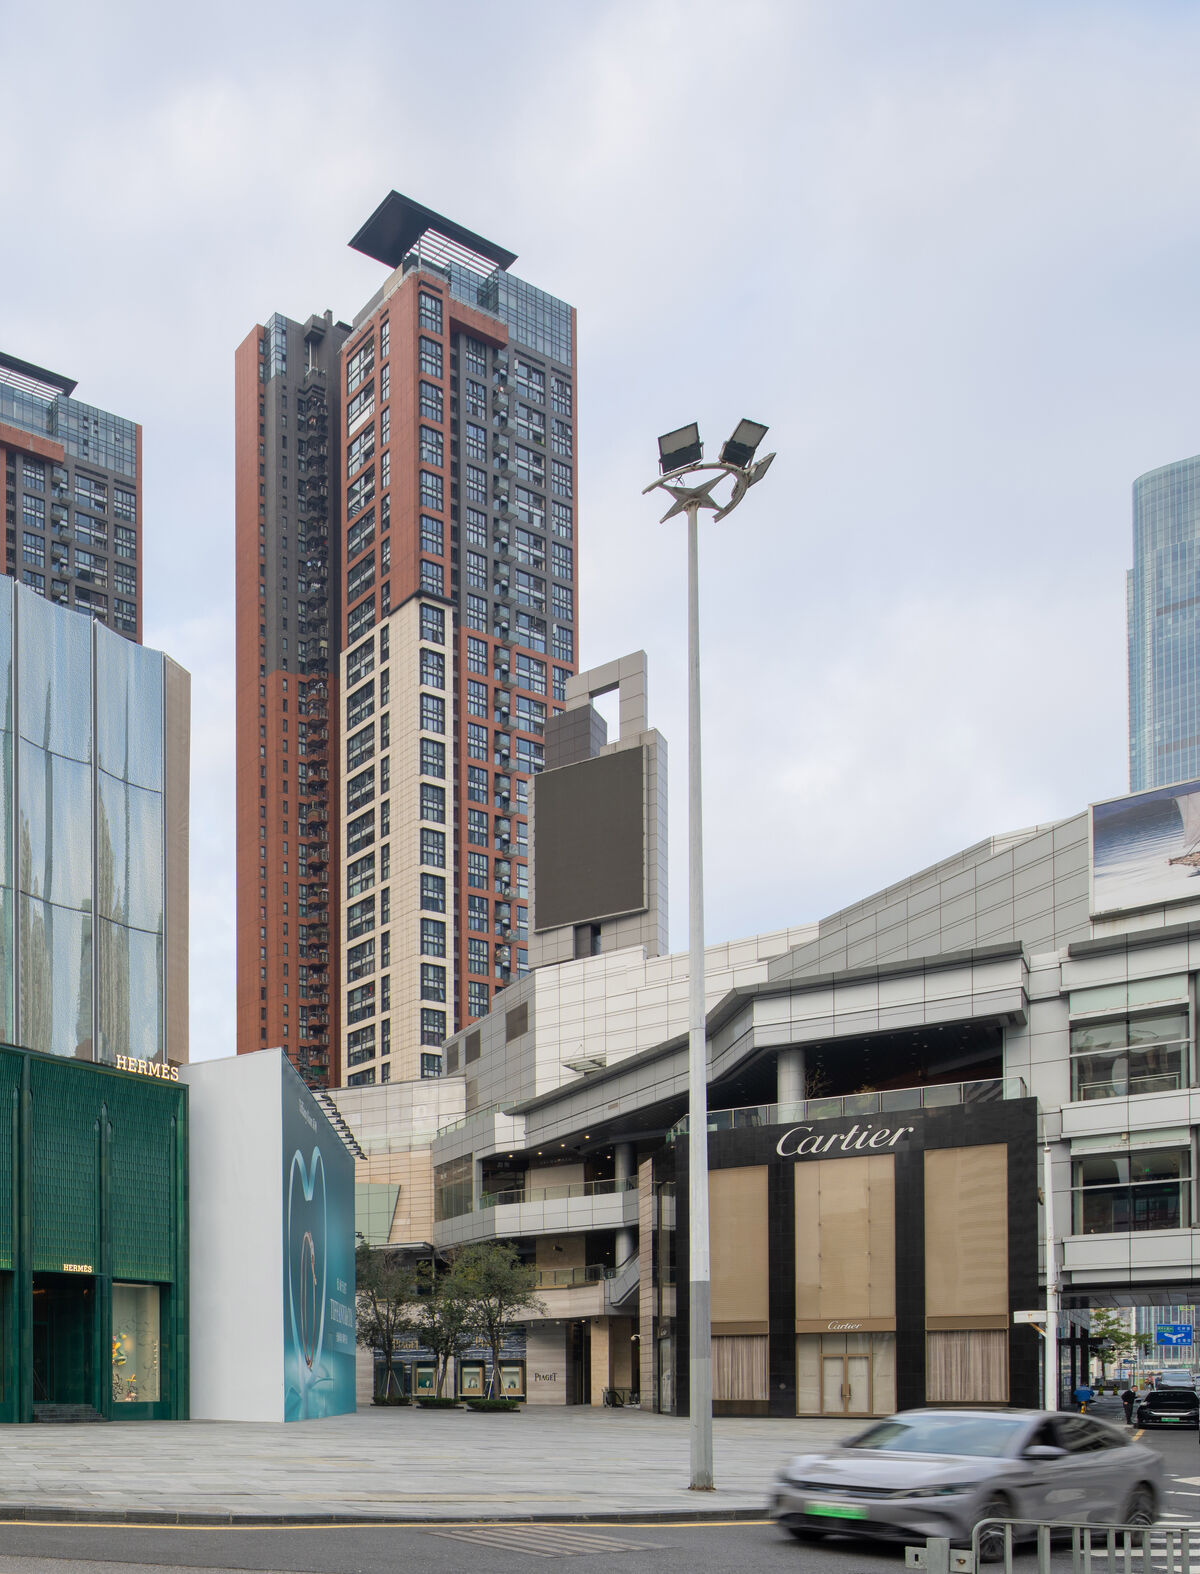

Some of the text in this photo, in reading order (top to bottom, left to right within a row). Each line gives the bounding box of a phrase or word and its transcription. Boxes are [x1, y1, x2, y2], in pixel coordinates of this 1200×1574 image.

[776, 1124, 914, 1156] Cartier
[827, 1320, 862, 1330] Cartier
[534, 1372, 558, 1382] PIAGET
